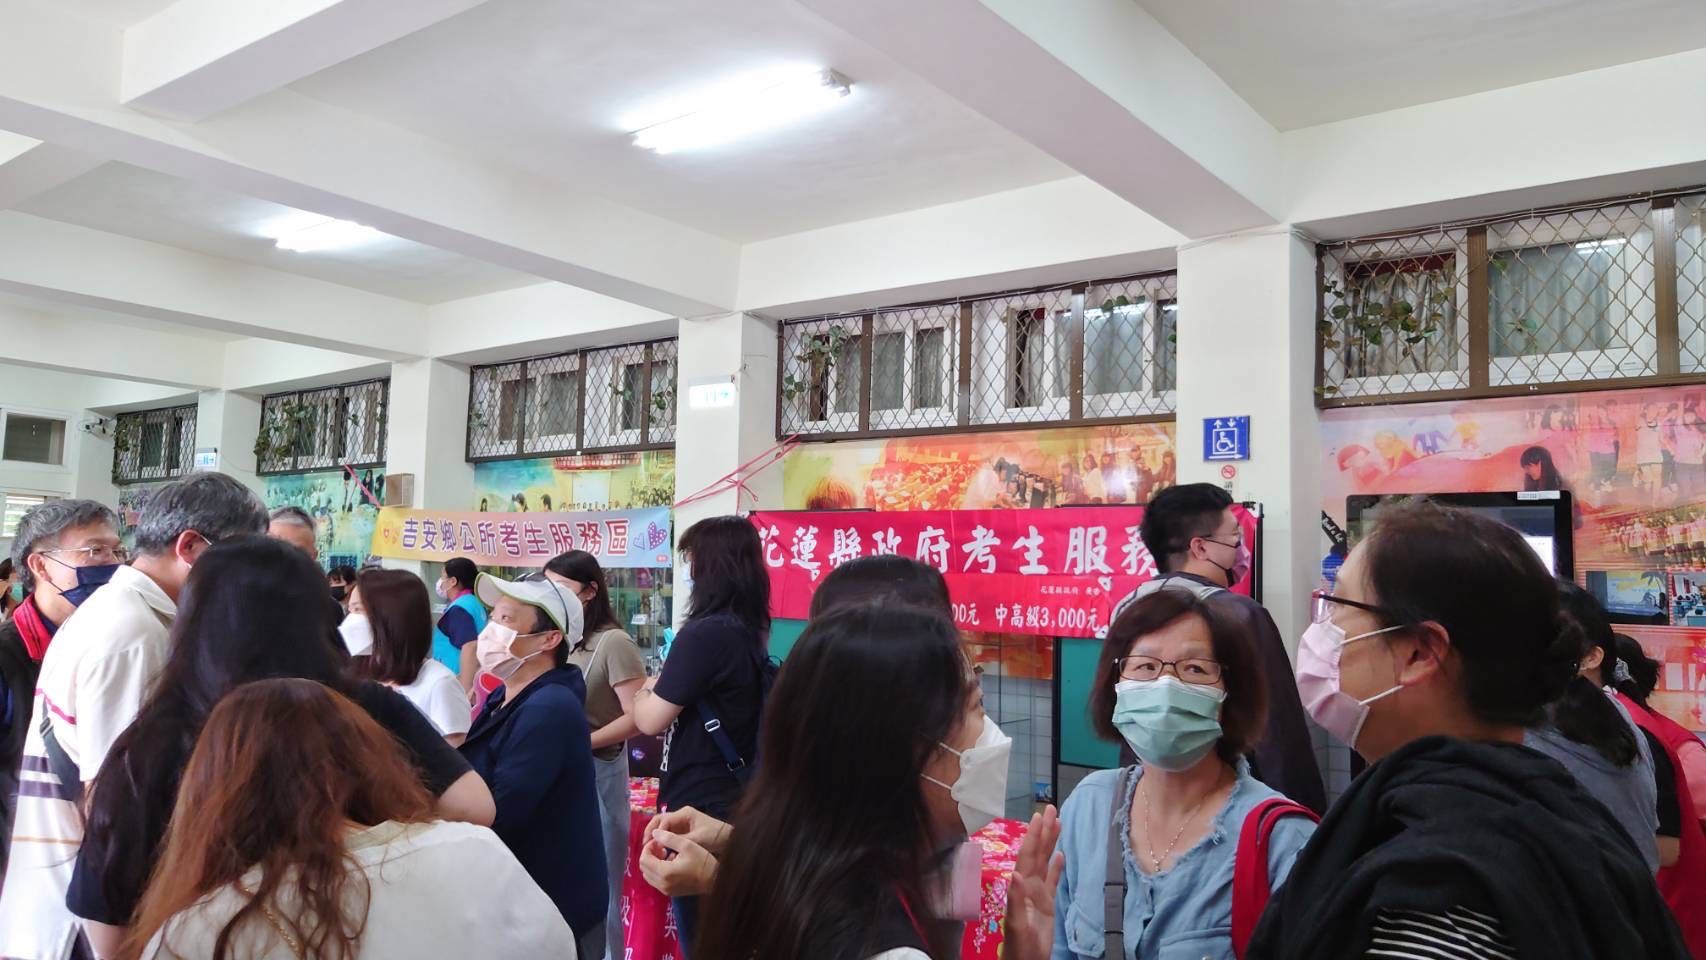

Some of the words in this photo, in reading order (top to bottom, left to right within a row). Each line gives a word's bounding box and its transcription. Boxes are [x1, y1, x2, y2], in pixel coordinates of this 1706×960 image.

[402, 517, 629, 557] 吉安鄉公所考生服務區
